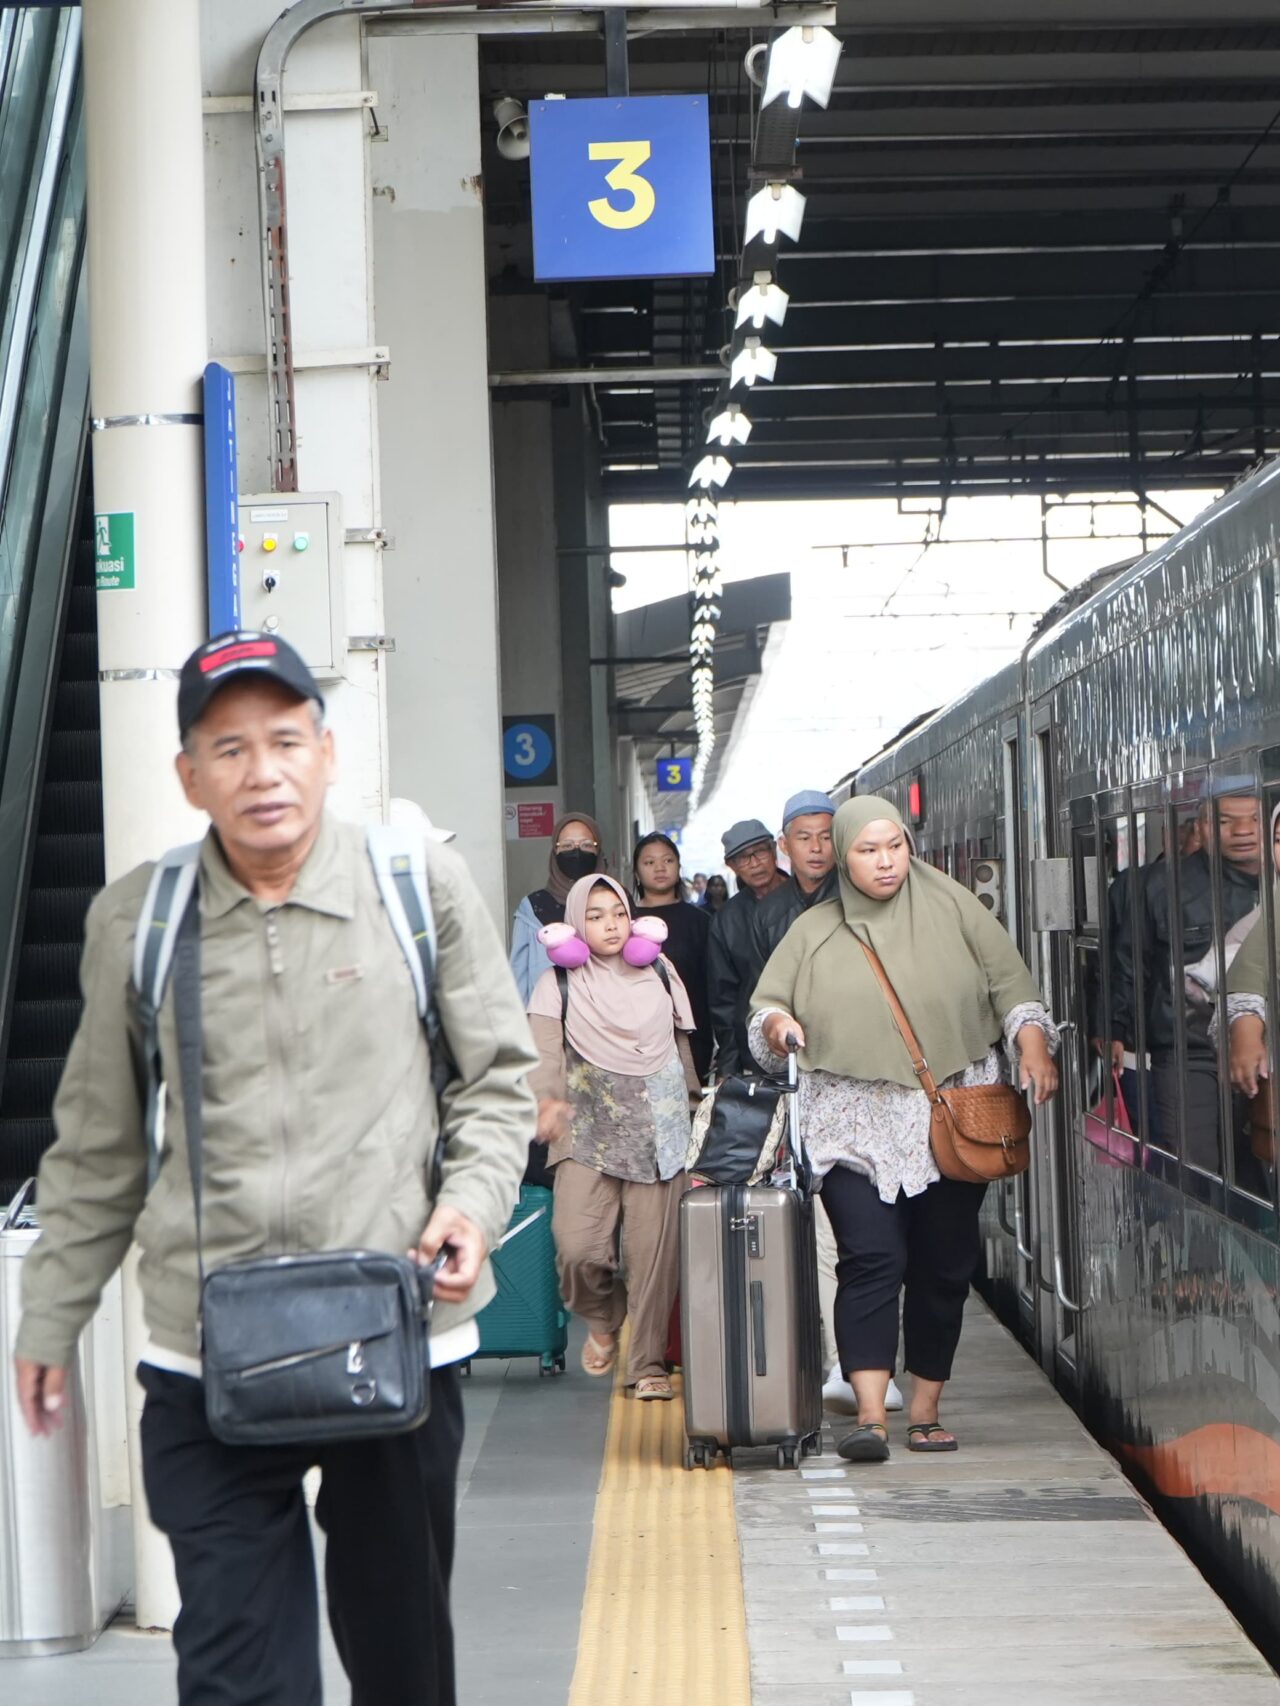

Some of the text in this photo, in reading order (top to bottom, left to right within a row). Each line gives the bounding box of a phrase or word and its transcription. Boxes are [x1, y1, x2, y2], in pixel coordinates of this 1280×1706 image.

[587, 140, 656, 230] 3
[227, 377, 238, 631] JATINEGA
[514, 732, 536, 766] 3
[667, 764, 682, 785] 3
